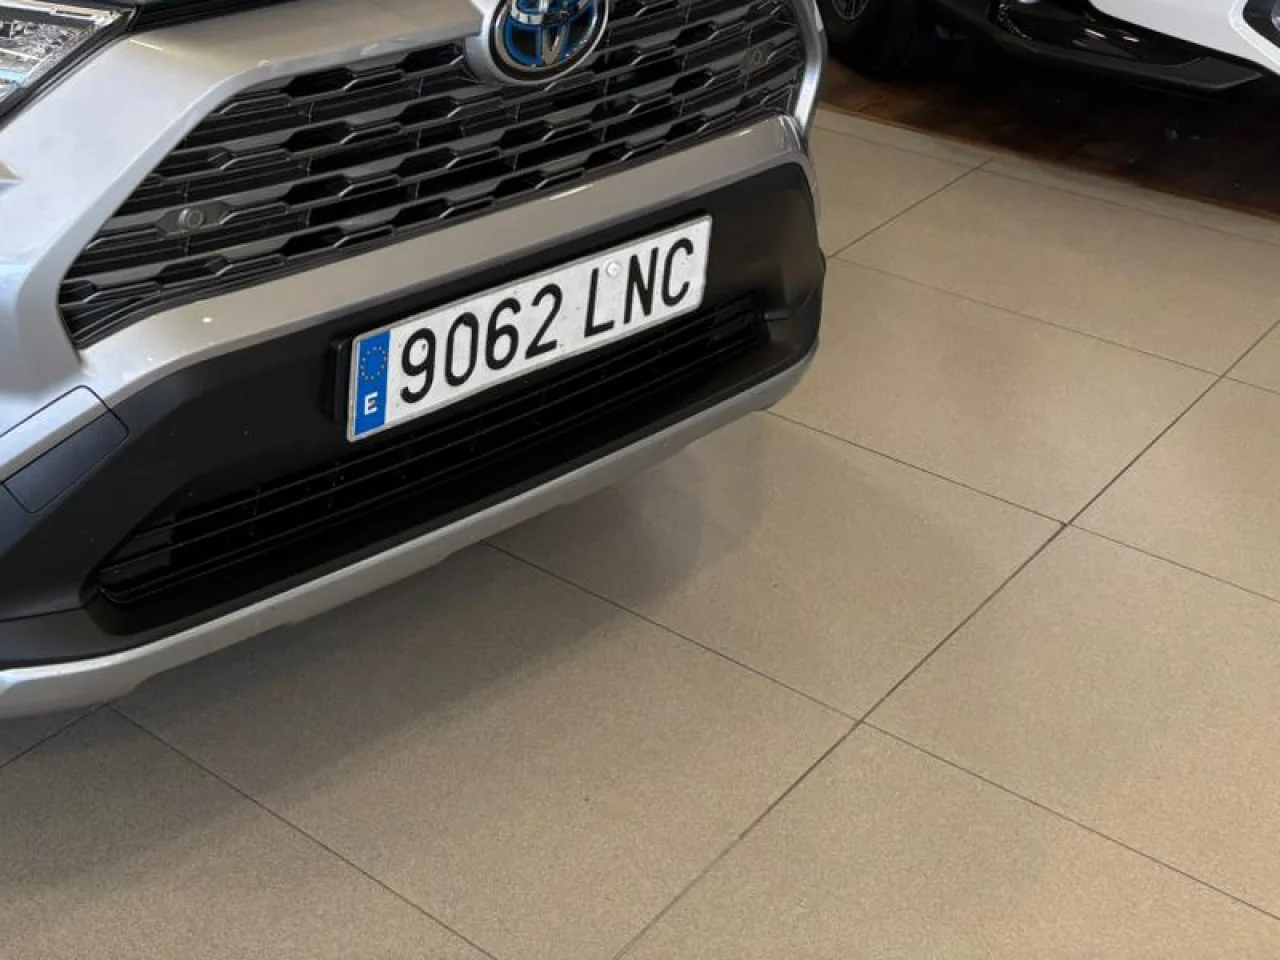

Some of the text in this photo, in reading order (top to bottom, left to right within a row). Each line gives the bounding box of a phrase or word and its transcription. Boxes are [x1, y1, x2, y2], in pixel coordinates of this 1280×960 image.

[400, 237, 694, 404] 9062 LNC
[363, 391, 378, 414] E
